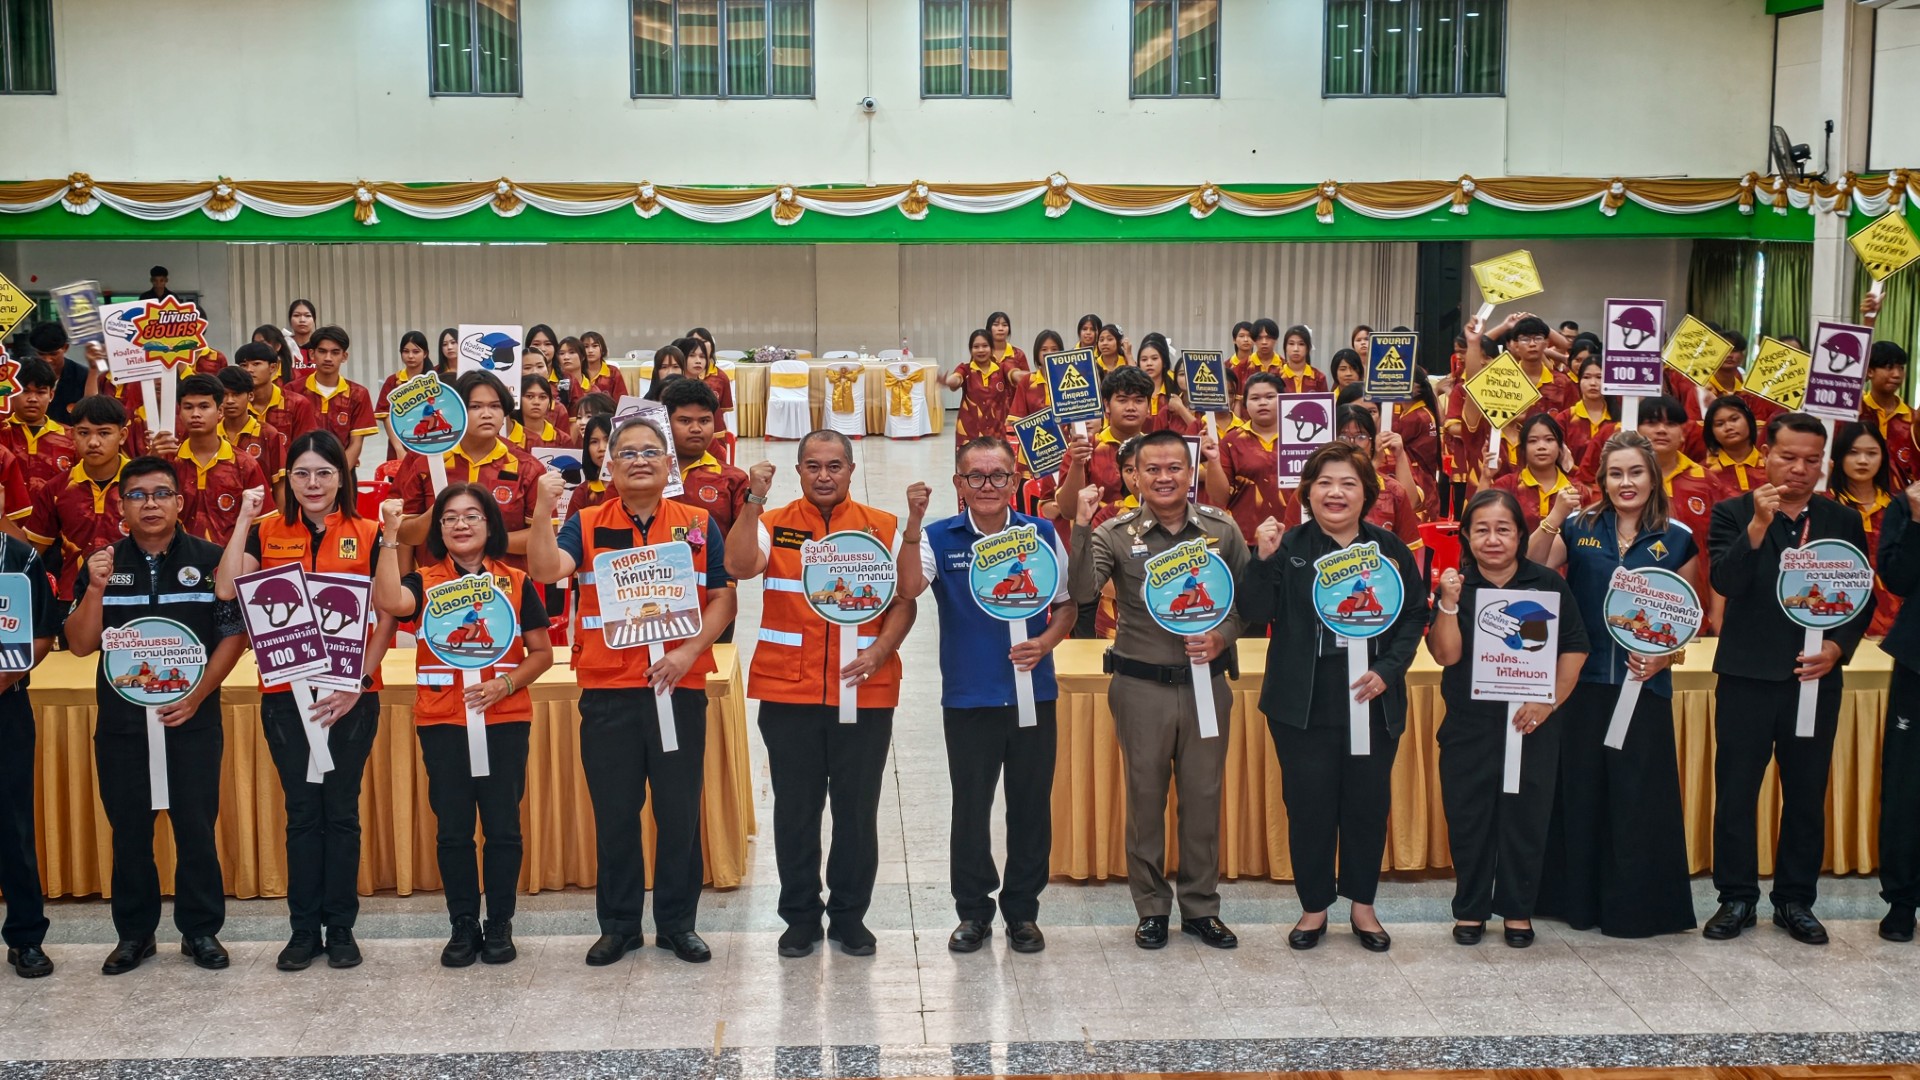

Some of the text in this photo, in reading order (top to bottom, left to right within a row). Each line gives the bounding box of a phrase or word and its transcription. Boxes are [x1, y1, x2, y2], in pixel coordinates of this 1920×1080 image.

[159, 311, 198, 324] ไม่ขับรถ
[143, 321, 197, 339] ย้อนศร
[1376, 337, 1411, 348] ขอบคุณ
[1051, 353, 1087, 366] ขอบคุณ
[1188, 354, 1217, 364] ขอบคุณ
[1759, 349, 1791, 364] หยุดรถ
[1494, 367, 1524, 377] หยุดรถ
[1612, 366, 1654, 381] 100 %
[390, 376, 435, 402] มอเตอร์ไซค์
[1490, 375, 1526, 389] ให้คนข้าม
[394, 385, 440, 415] ปลอดภัย
[1485, 388, 1528, 401] ทางม้าลาย
[1814, 388, 1854, 407] 100 %
[1020, 413, 1050, 430] ขอบคุณ
[804, 543, 836, 554] ร่วมกัน
[977, 529, 1034, 553] มอเตอร์ไซค์
[611, 549, 657, 571] หยุดรถ
[805, 553, 875, 564] สร้างวัฒนธรรม
[977, 540, 1036, 569] ปลอดภัย
[1150, 543, 1203, 571] มอเตอร์ไซค์
[1320, 546, 1375, 570] มอเตอร์ไซค์
[1784, 549, 1816, 560] ร่วมกัน
[829, 563, 894, 573] ความปลอดภัย
[1151, 554, 1208, 586] ปลอดภัย
[1321, 557, 1379, 586] ปลอดภัย
[1783, 559, 1853, 570] สร้างวัฒนธรรม
[613, 565, 672, 588] ให้คนข้าม
[857, 572, 895, 582] ทางถนน
[1615, 571, 1648, 586] ร่วมกัน
[1805, 570, 1871, 580] ความปลอดภัย
[430, 578, 489, 599] มอเตอร์ไซค์
[617, 581, 683, 601] ทางม้าลาย
[1832, 579, 1870, 588] ทางถนน
[1613, 581, 1683, 603] สร้างวัฒนธรรม
[431, 589, 492, 615] ปลอดภัย
[1634, 596, 1700, 618] ความปลอดภัย
[1659, 611, 1698, 626] ทางถนน
[105, 627, 140, 640] ร่วมกัน
[256, 625, 318, 649] สวมหมวกนิรภัย
[106, 636, 181, 650] สร้างวัฒนธรรม
[133, 646, 202, 659] ความปลอดภัย
[163, 655, 203, 665] ทางถนน
[267, 641, 317, 667] 100 %
[1481, 652, 1529, 665] ห่วงใคร...
[340, 657, 353, 674] %
[1496, 667, 1548, 679] ให้ใส่หมวก
